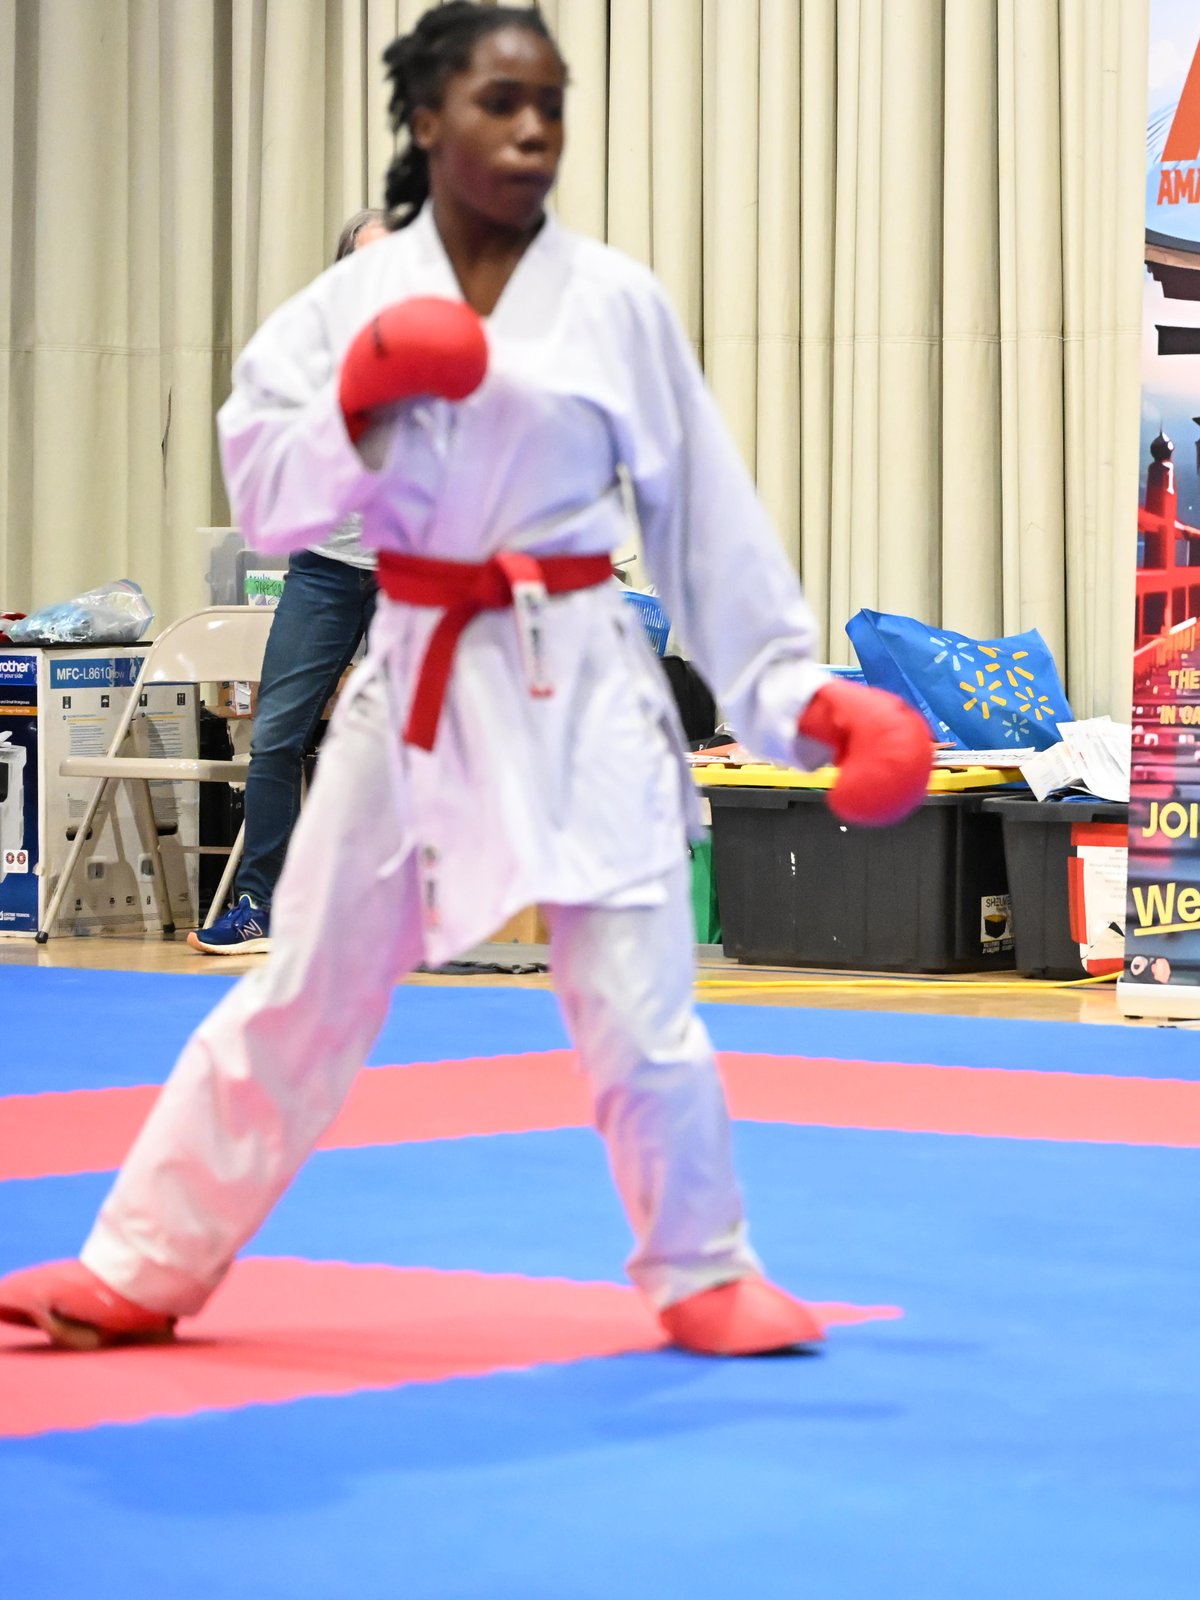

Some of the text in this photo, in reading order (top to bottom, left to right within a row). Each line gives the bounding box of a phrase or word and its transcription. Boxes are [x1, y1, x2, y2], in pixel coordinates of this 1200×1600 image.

[0, 660, 30, 673] rother
[1167, 670, 1200, 690] THE
[1159, 705, 1176, 725] IN
